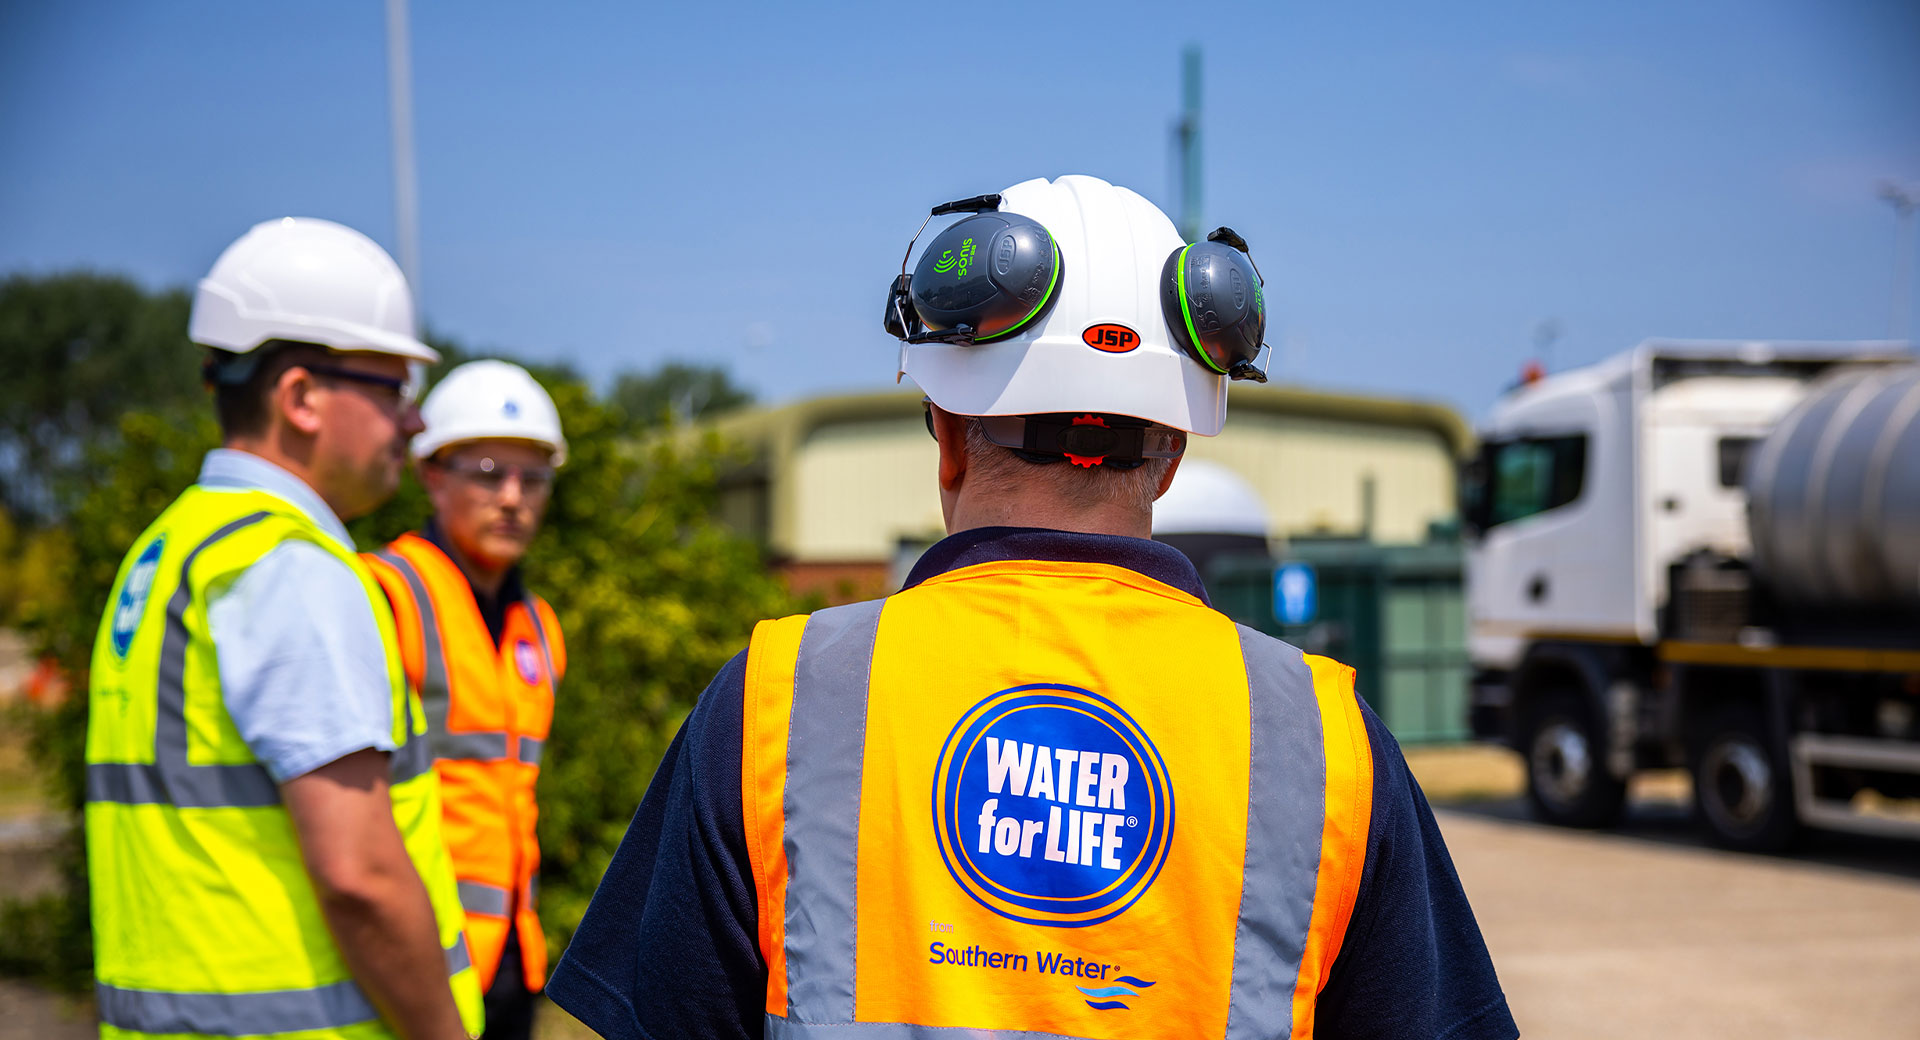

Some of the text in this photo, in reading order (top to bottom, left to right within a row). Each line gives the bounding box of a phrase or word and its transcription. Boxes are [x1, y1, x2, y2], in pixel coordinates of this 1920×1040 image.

[1091, 329, 1133, 347] JSP
[986, 736, 1129, 810] WATER
[978, 798, 1044, 858] for
[929, 919, 954, 934] from
[929, 941, 1028, 972] Southern
